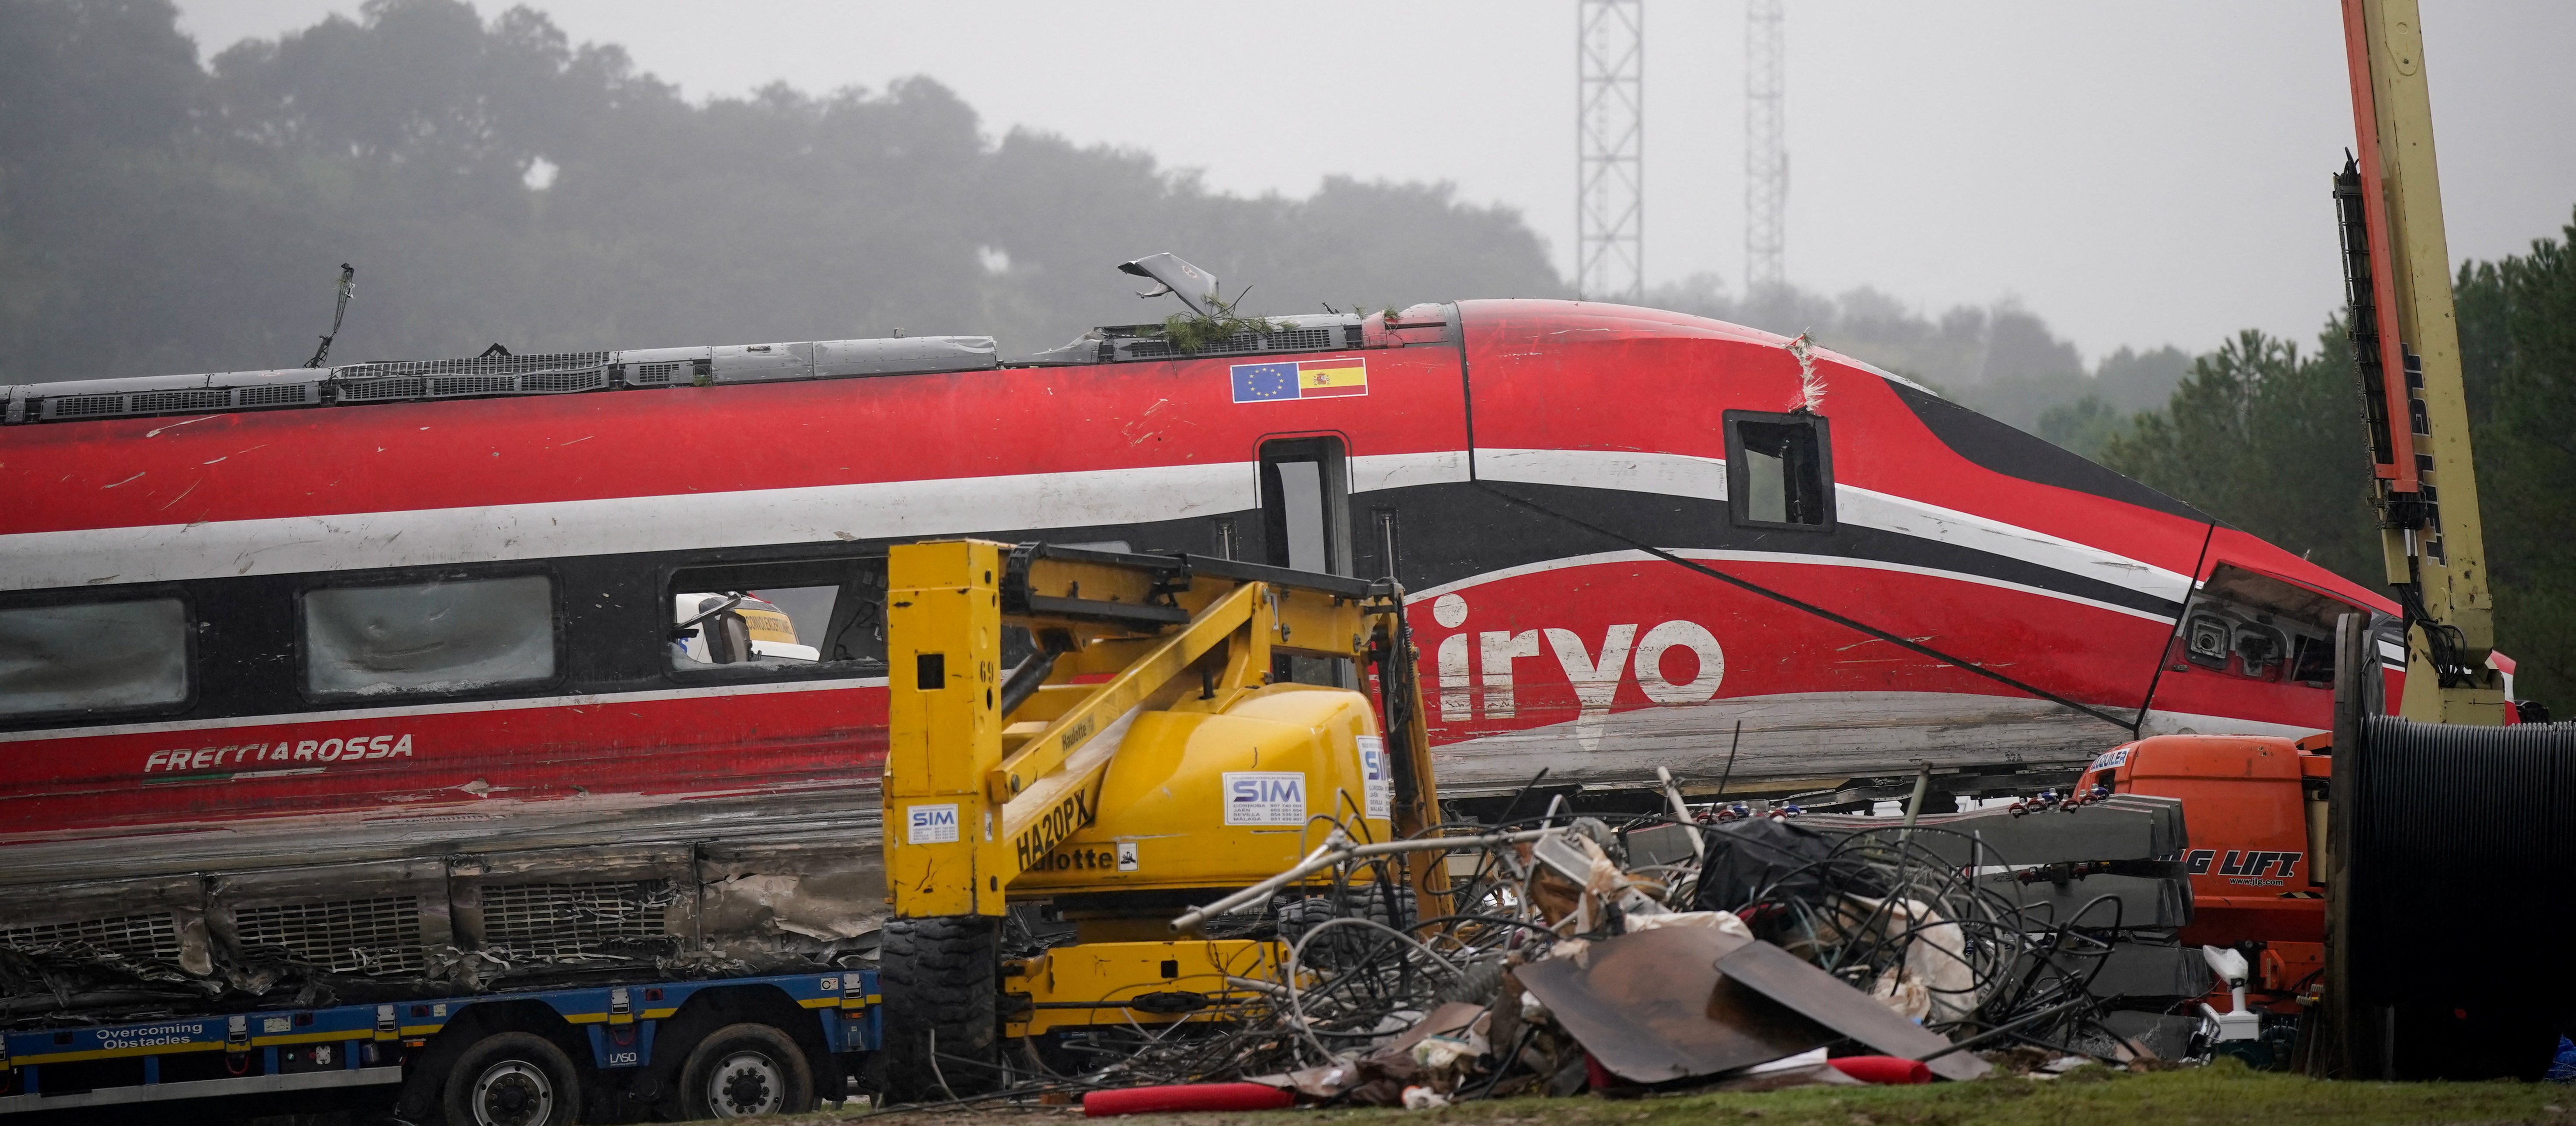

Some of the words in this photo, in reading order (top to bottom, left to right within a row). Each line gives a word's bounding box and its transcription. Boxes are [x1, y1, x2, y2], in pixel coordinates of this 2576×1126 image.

[2401, 342, 2430, 436] JLG
[980, 660, 994, 683] 69
[1433, 593, 1725, 751] iryo
[1062, 723, 1087, 751] Haulotte
[145, 734, 413, 773] FRECCIAROSSA
[2090, 751, 2127, 770] ALQUILER
[1233, 780, 1301, 802] SIM
[913, 811, 954, 826] SIM
[1016, 788, 1089, 872] HA20PX
[2230, 878, 2284, 886] www.jlg.com
[96, 1024, 202, 1040] Overcoming
[103, 1035, 190, 1050] Obstacles
[610, 1052, 637, 1063] LASO
